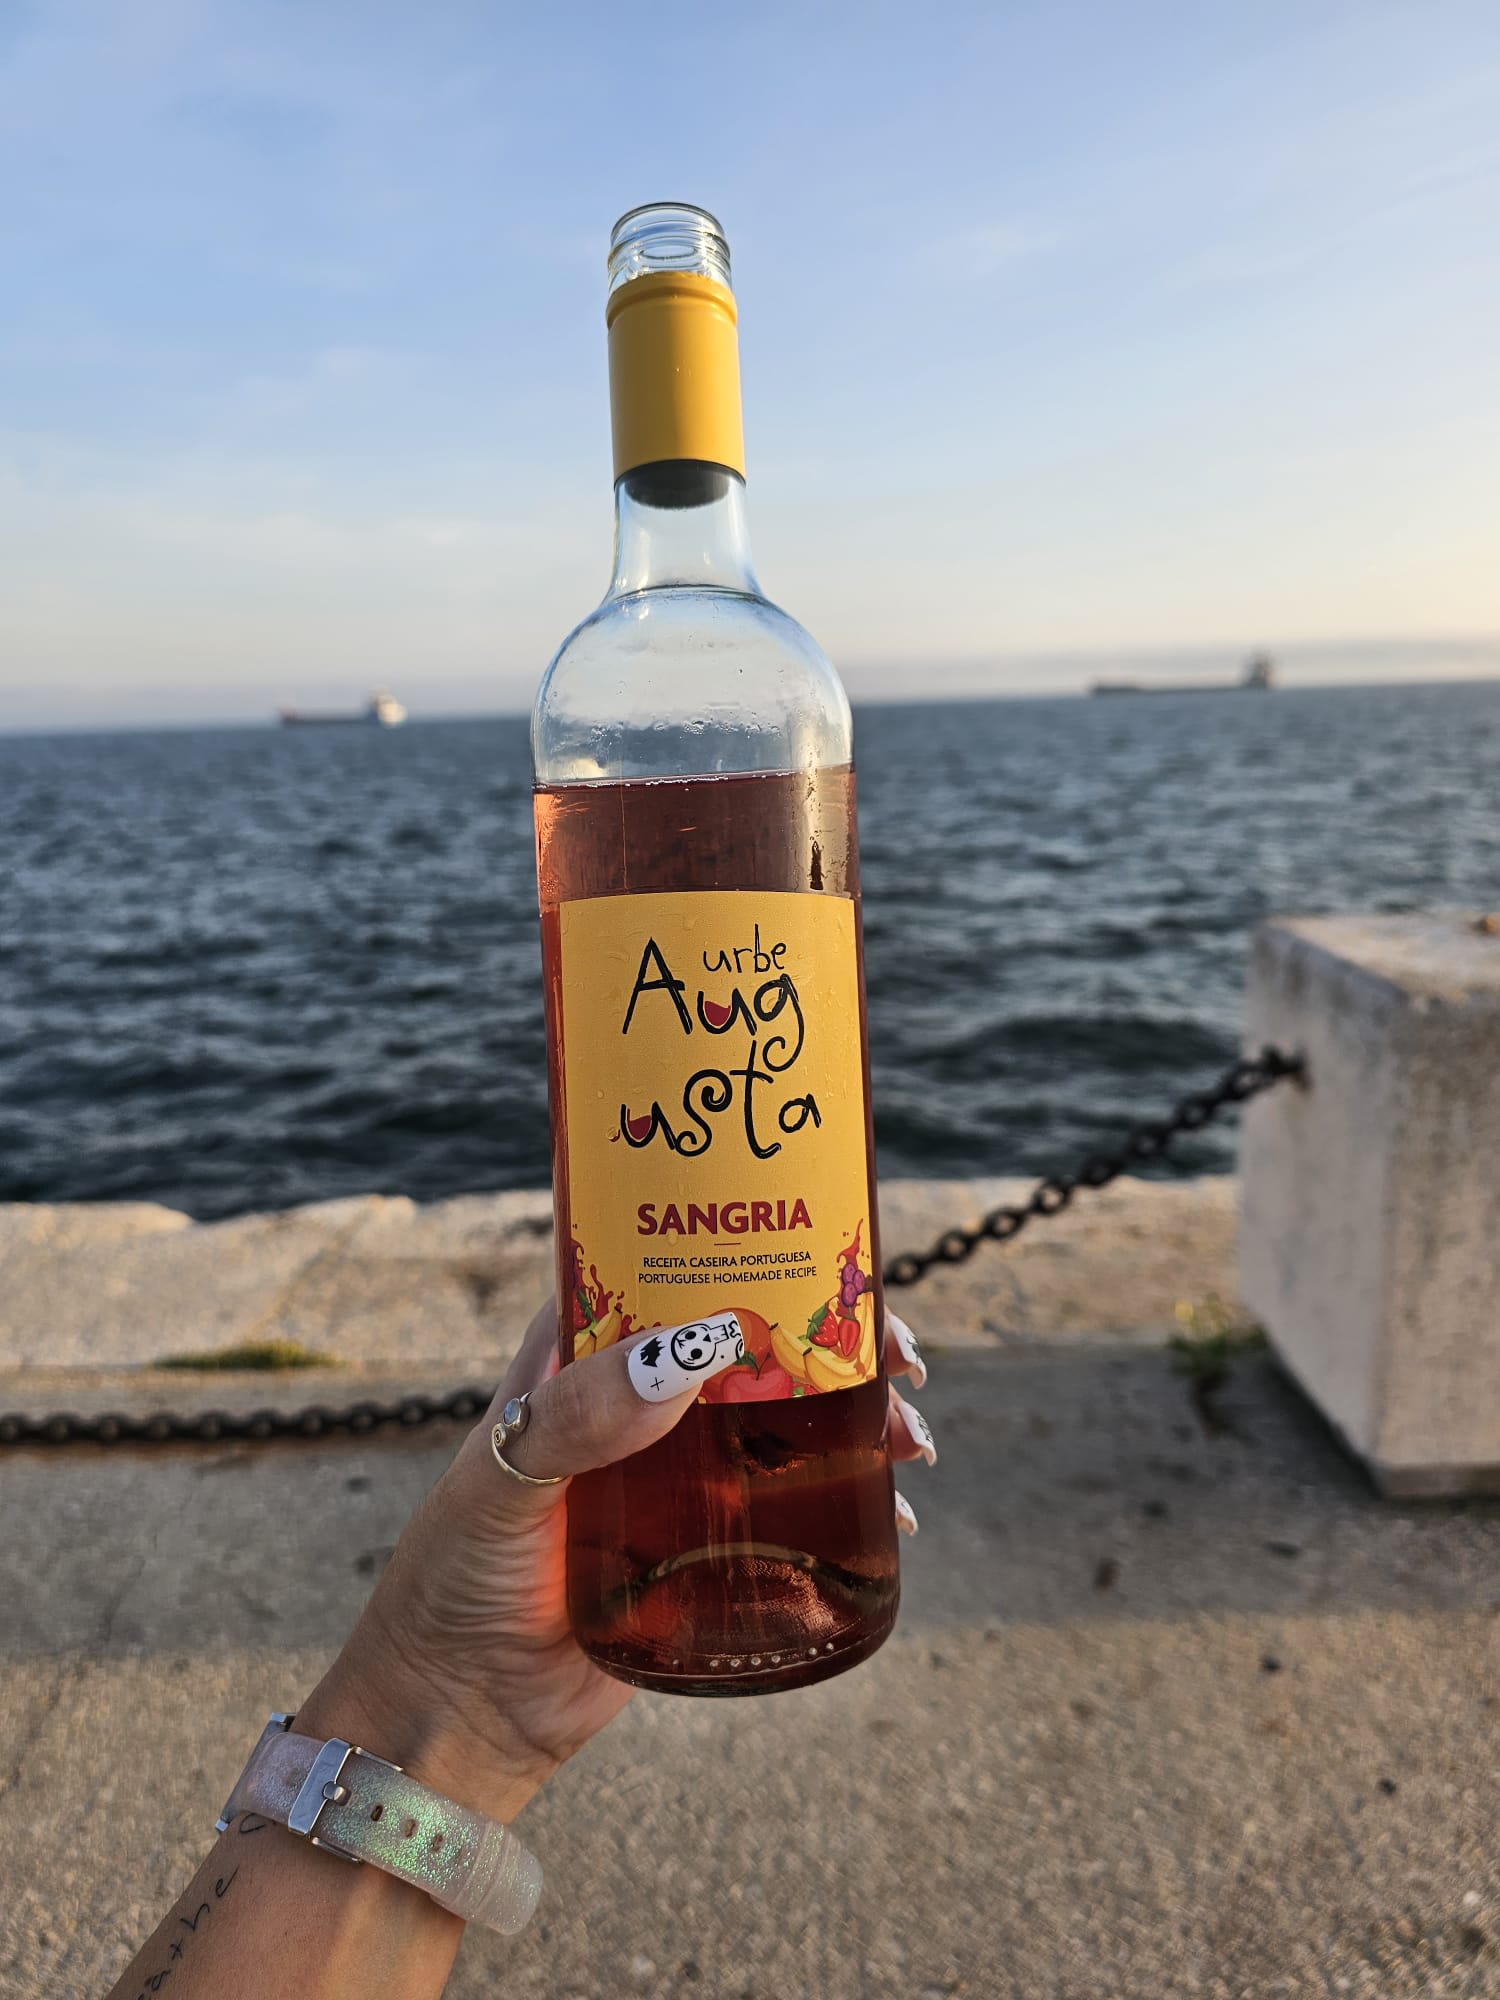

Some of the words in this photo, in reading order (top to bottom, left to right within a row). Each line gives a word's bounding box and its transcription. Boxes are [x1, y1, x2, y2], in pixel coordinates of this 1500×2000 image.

[704, 923, 787, 973] urbe
[637, 1198, 813, 1236] SANGRIA
[643, 1257, 687, 1268] RECEITA
[689, 1256, 737, 1268] CASEIRA
[740, 1251, 812, 1266] PORTUGUESA
[638, 1273, 710, 1284] PORTUGUESE
[713, 1269, 782, 1283] HOMEMADE
[784, 1266, 817, 1279] RECIPE
